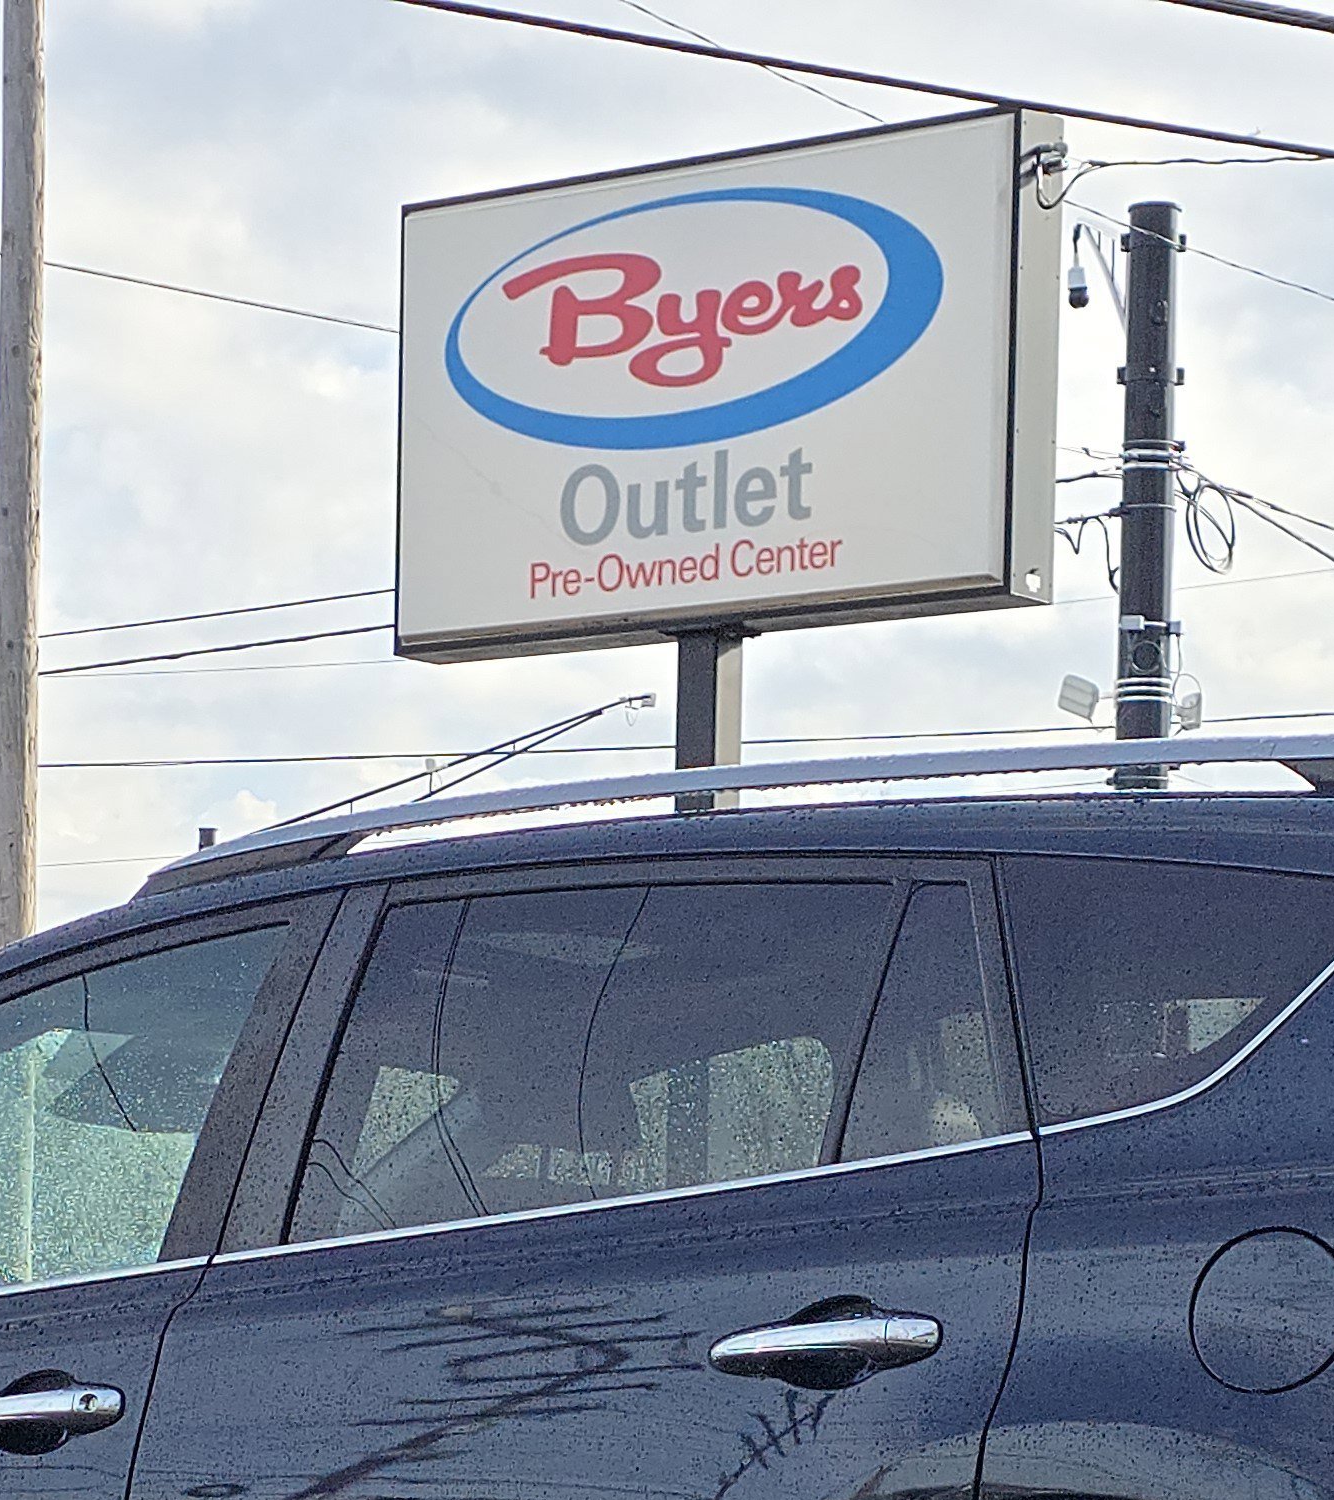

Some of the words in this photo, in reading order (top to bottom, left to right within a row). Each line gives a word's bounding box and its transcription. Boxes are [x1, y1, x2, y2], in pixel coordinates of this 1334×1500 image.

[502, 253, 862, 387] Byers
[560, 447, 813, 546] Outlet
[529, 543, 721, 600] Pre-Owned
[730, 536, 843, 577] Center
